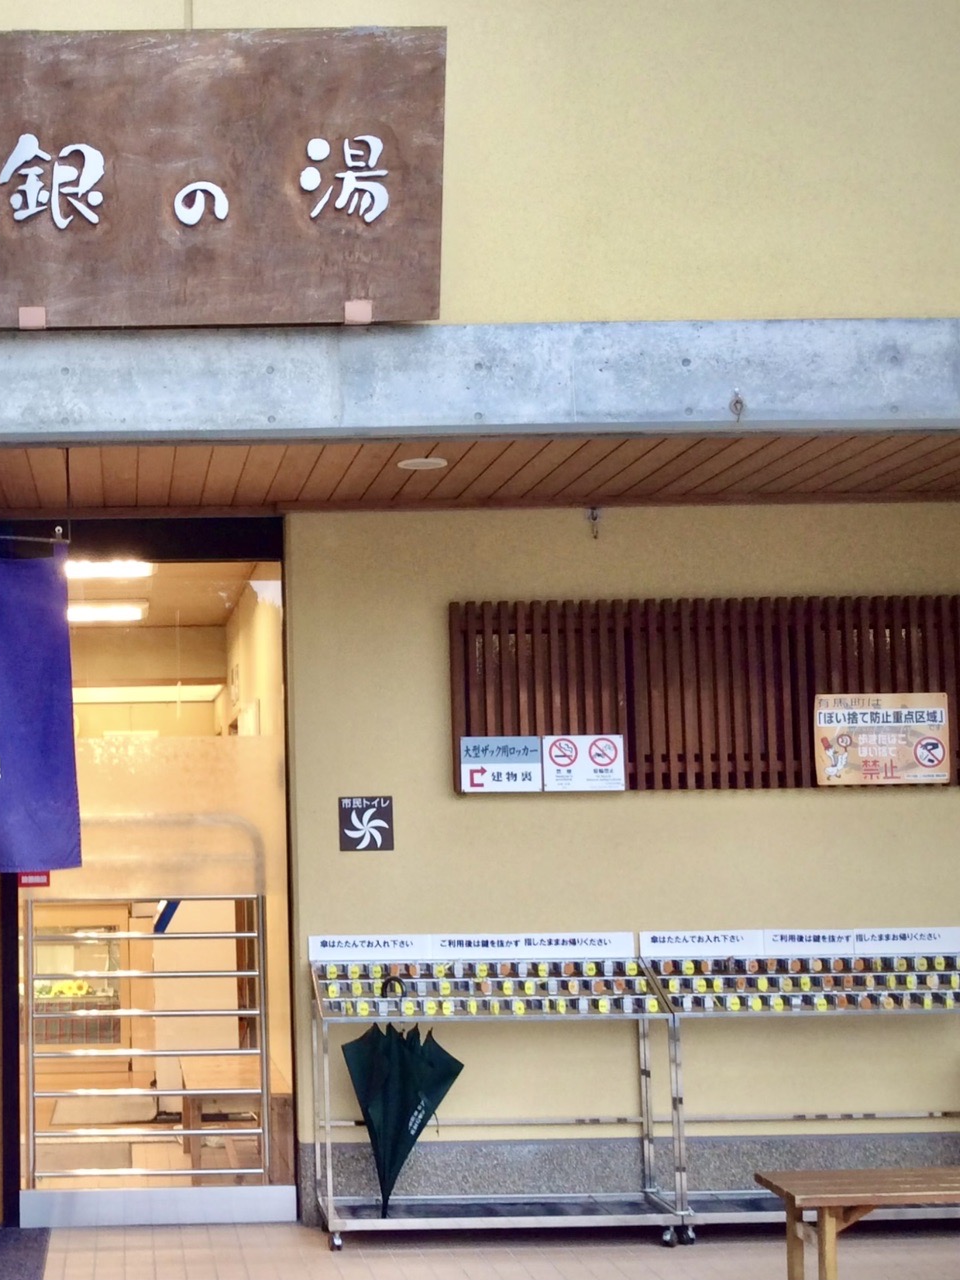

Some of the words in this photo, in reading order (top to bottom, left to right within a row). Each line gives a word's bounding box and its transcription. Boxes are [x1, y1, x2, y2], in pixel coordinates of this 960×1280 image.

[464, 744, 538, 758] 大型ザック用ロッカー
[862, 759, 901, 780] 禁止
[341, 797, 390, 808] 市民トイレ
